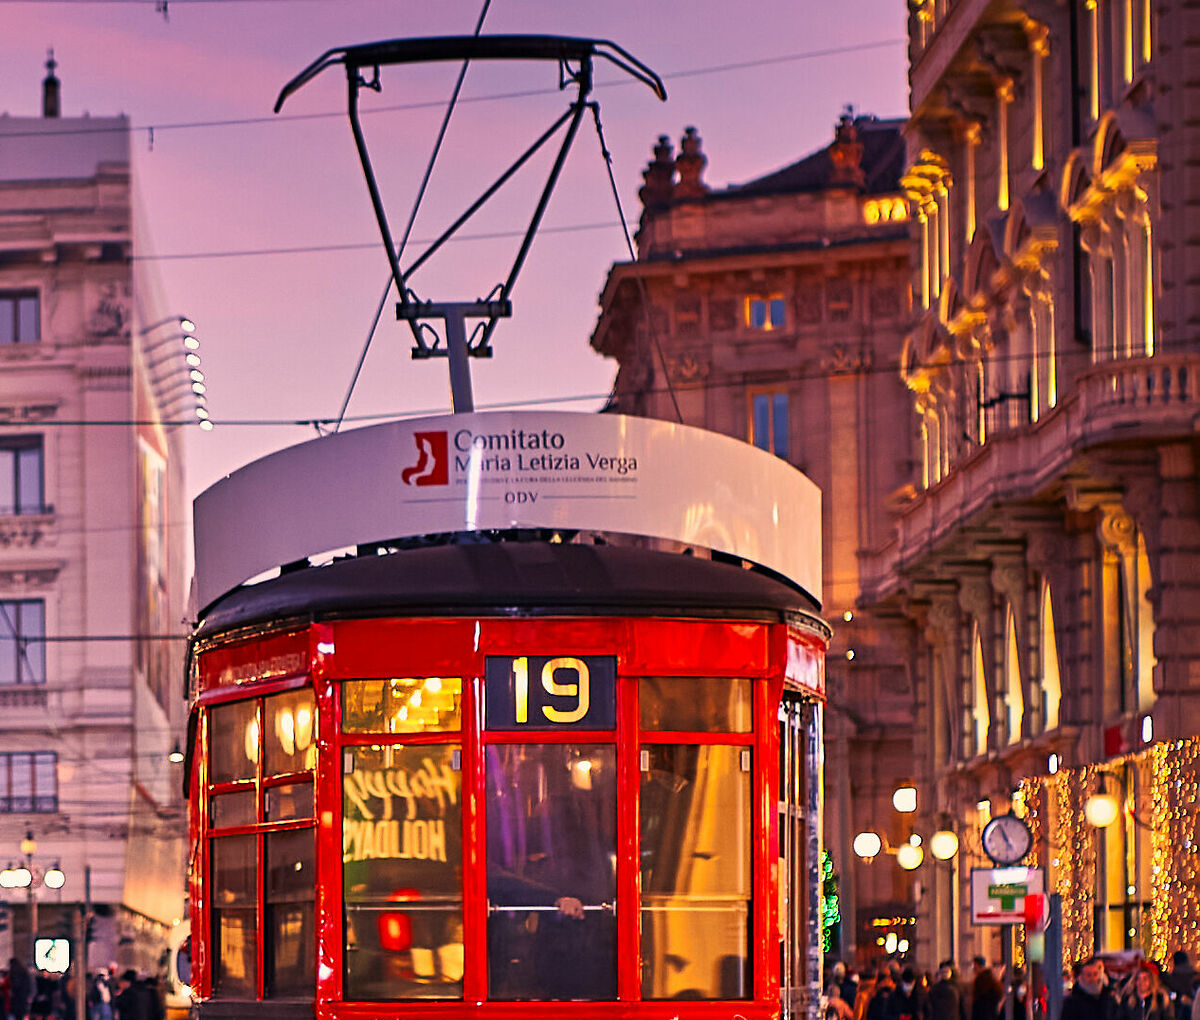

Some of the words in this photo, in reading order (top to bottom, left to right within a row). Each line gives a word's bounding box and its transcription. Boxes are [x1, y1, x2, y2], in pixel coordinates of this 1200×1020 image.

[454, 429, 564, 451] Comitato
[518, 453, 580, 471] Letizia
[586, 452, 638, 475] Verga
[504, 491, 538, 504] ODV
[510, 657, 591, 723] 19
